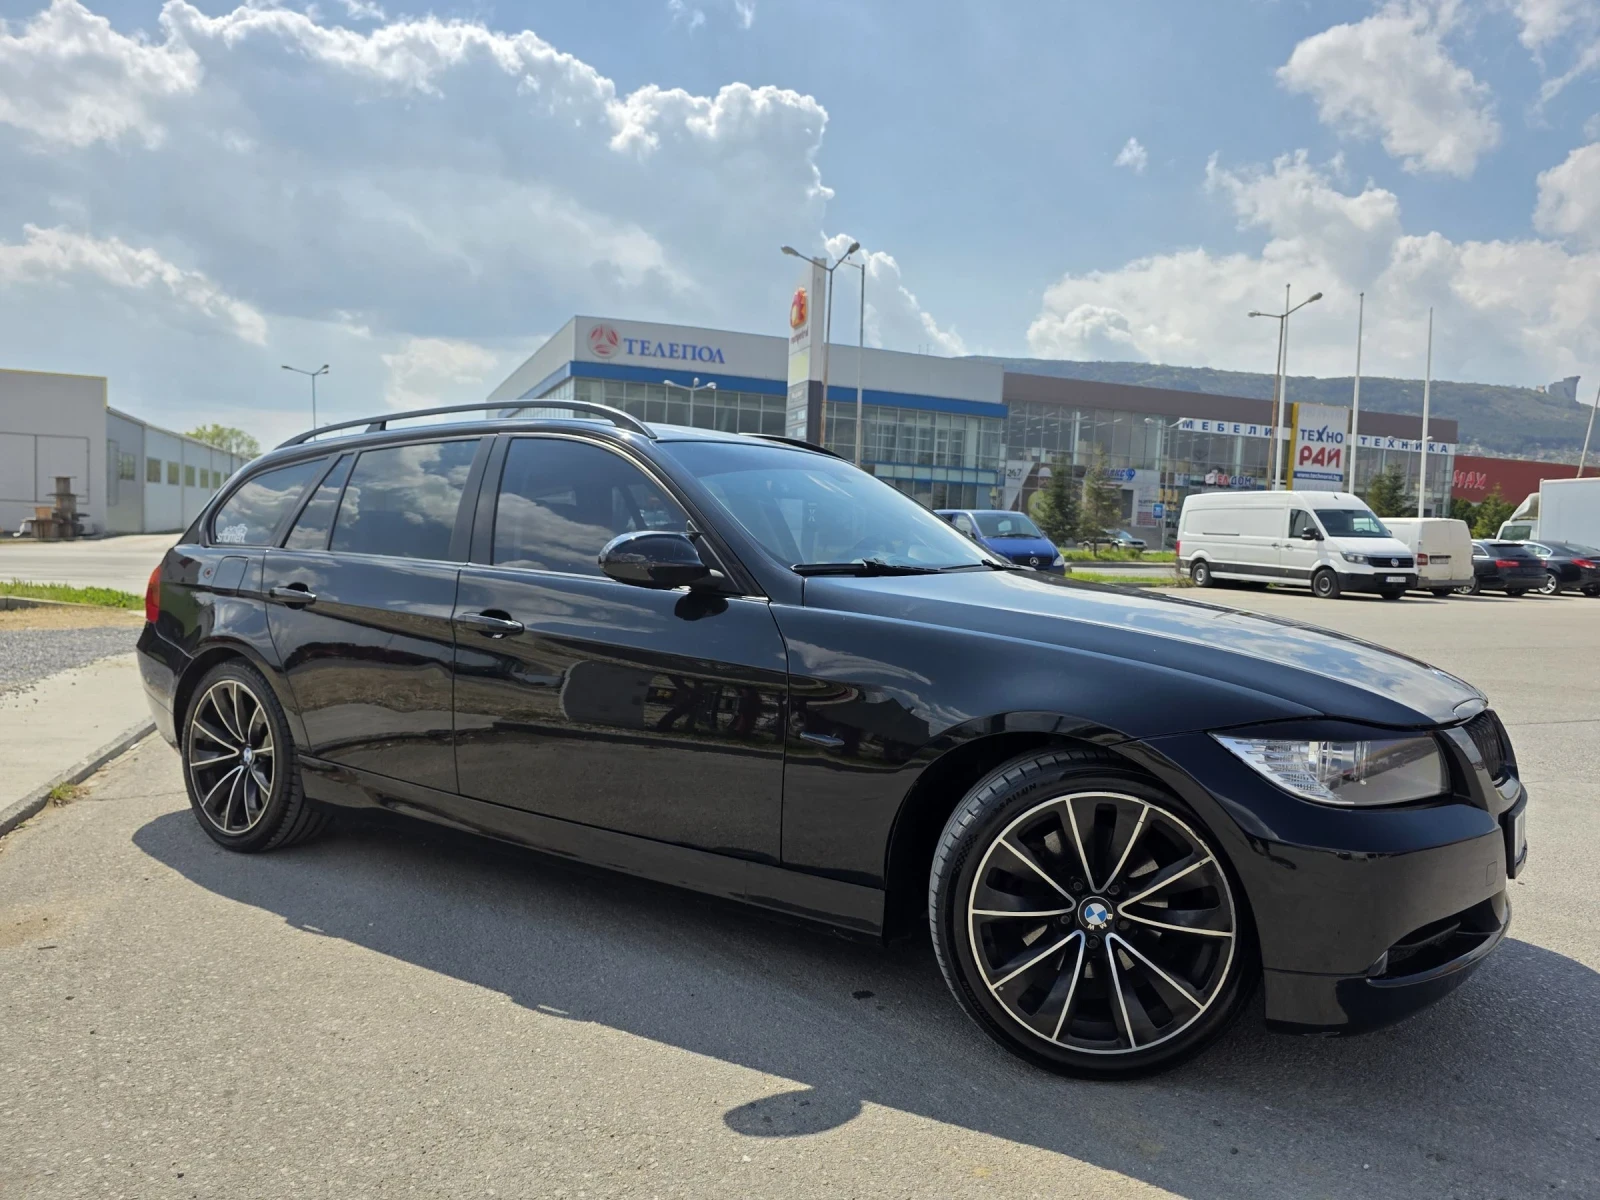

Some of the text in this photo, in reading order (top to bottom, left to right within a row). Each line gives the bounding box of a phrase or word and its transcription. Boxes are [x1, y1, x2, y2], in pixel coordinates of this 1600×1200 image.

[623, 338, 725, 364] ТЕЛЕПОЛ
[1182, 420, 1274, 437] МЕБЕЛИ
[1300, 425, 1343, 444] ТЕХНО
[1360, 437, 1448, 453] ТЕХНИКА
[1299, 446, 1341, 468] РАЙ
